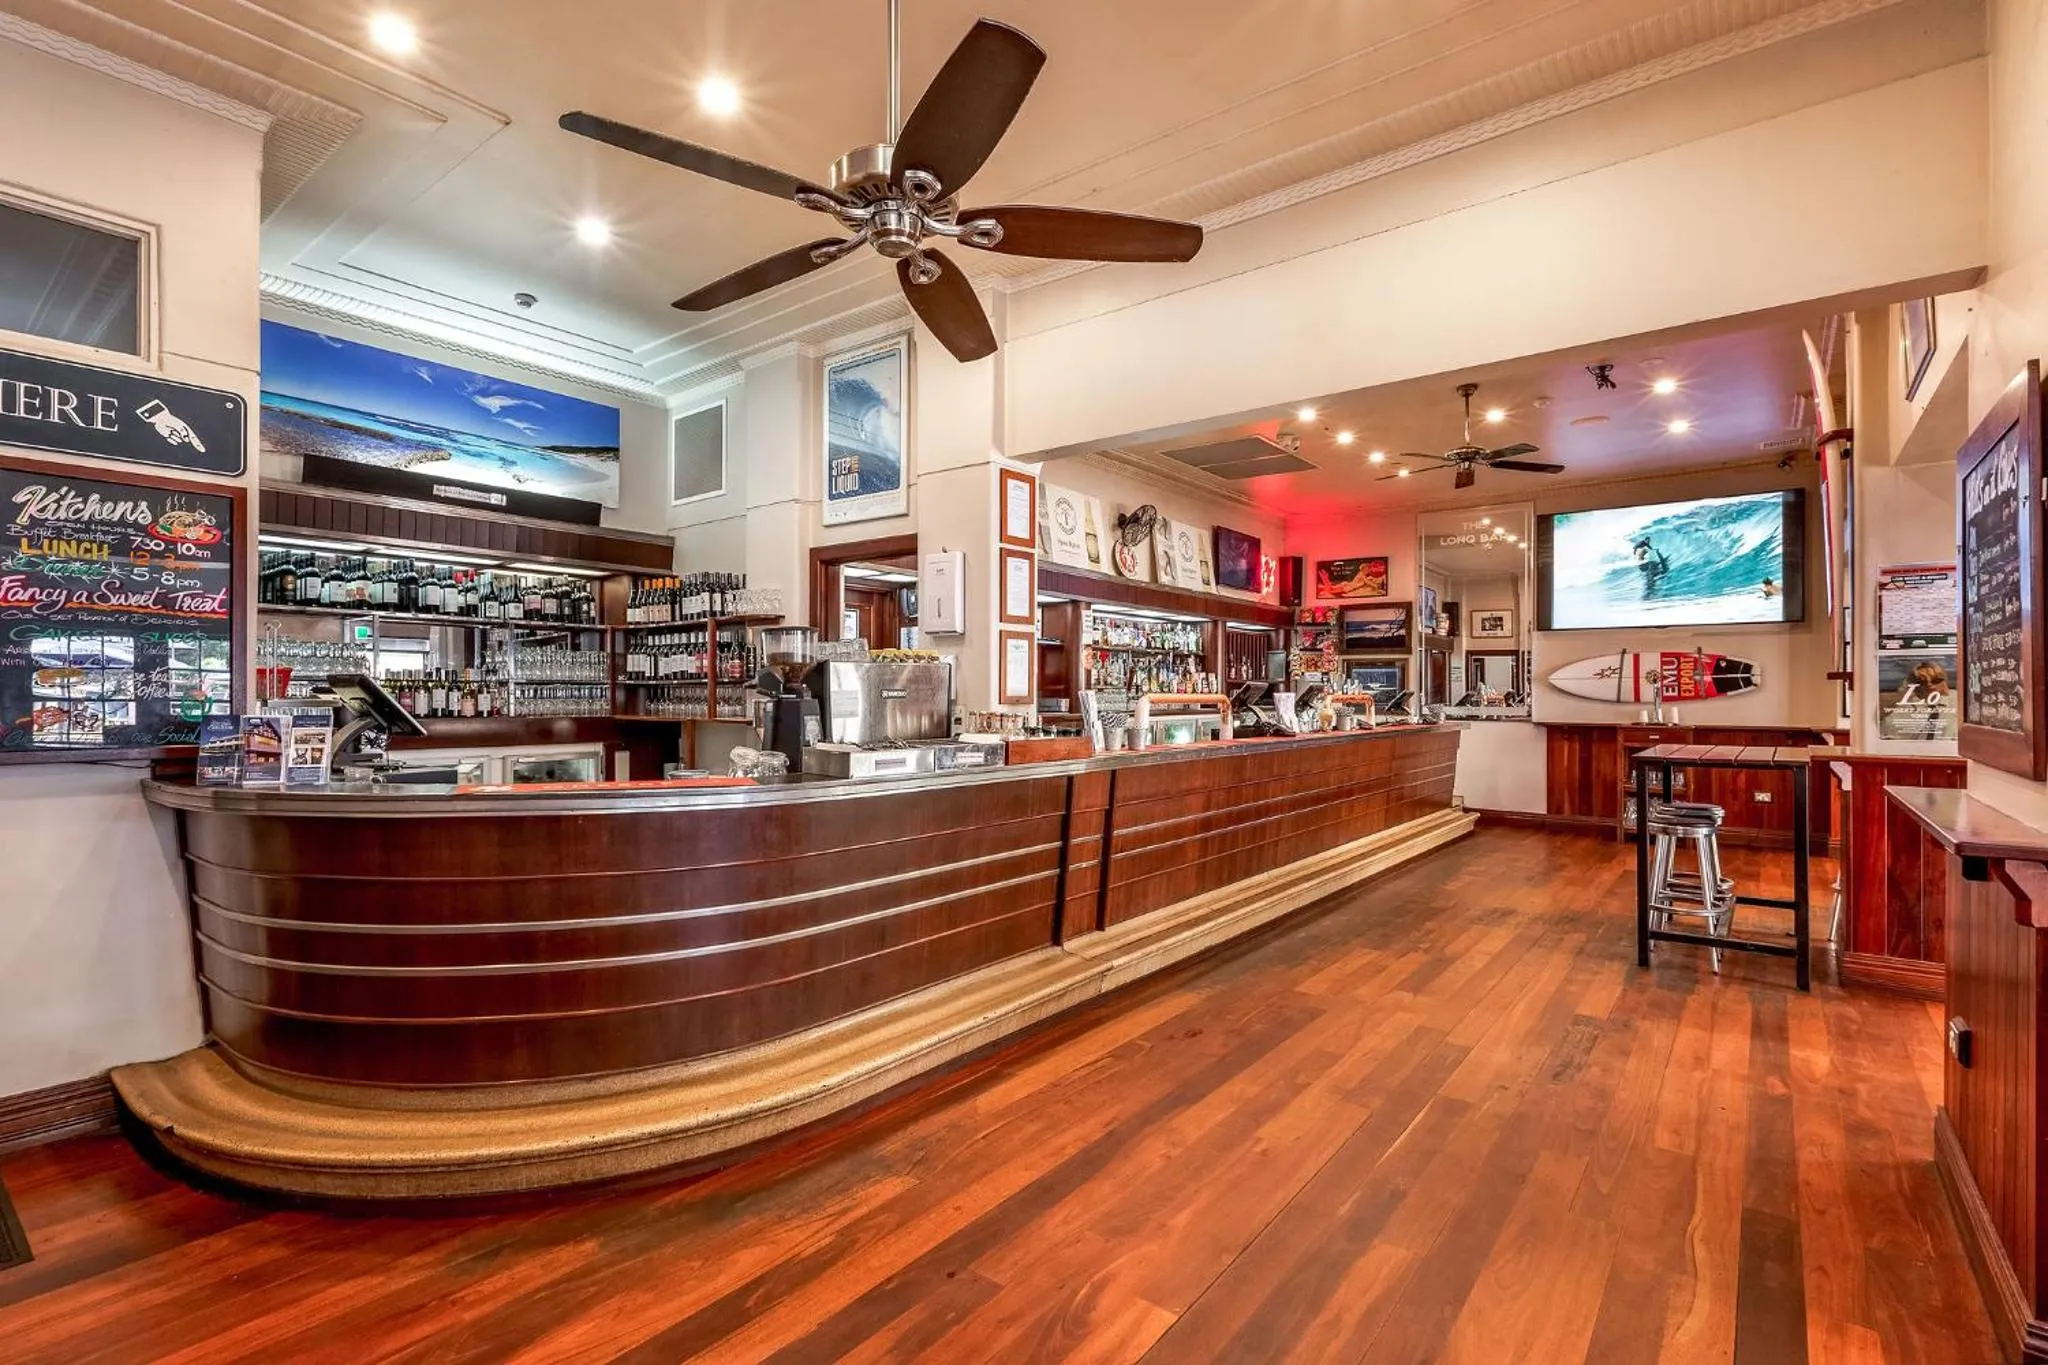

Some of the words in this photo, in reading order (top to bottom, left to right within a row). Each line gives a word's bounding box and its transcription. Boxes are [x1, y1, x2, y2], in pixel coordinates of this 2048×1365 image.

[12, 484, 151, 525] Kitchens
[20, 537, 111, 561] LUNCH
[1440, 534, 1476, 546] LONG
[0, 575, 68, 613] Fancy
[72, 587, 91, 603] a
[93, 580, 165, 609] Sweet
[169, 587, 228, 611] Treat
[1662, 657, 1678, 696] EMU
[1680, 656, 1695, 697] EXPORT
